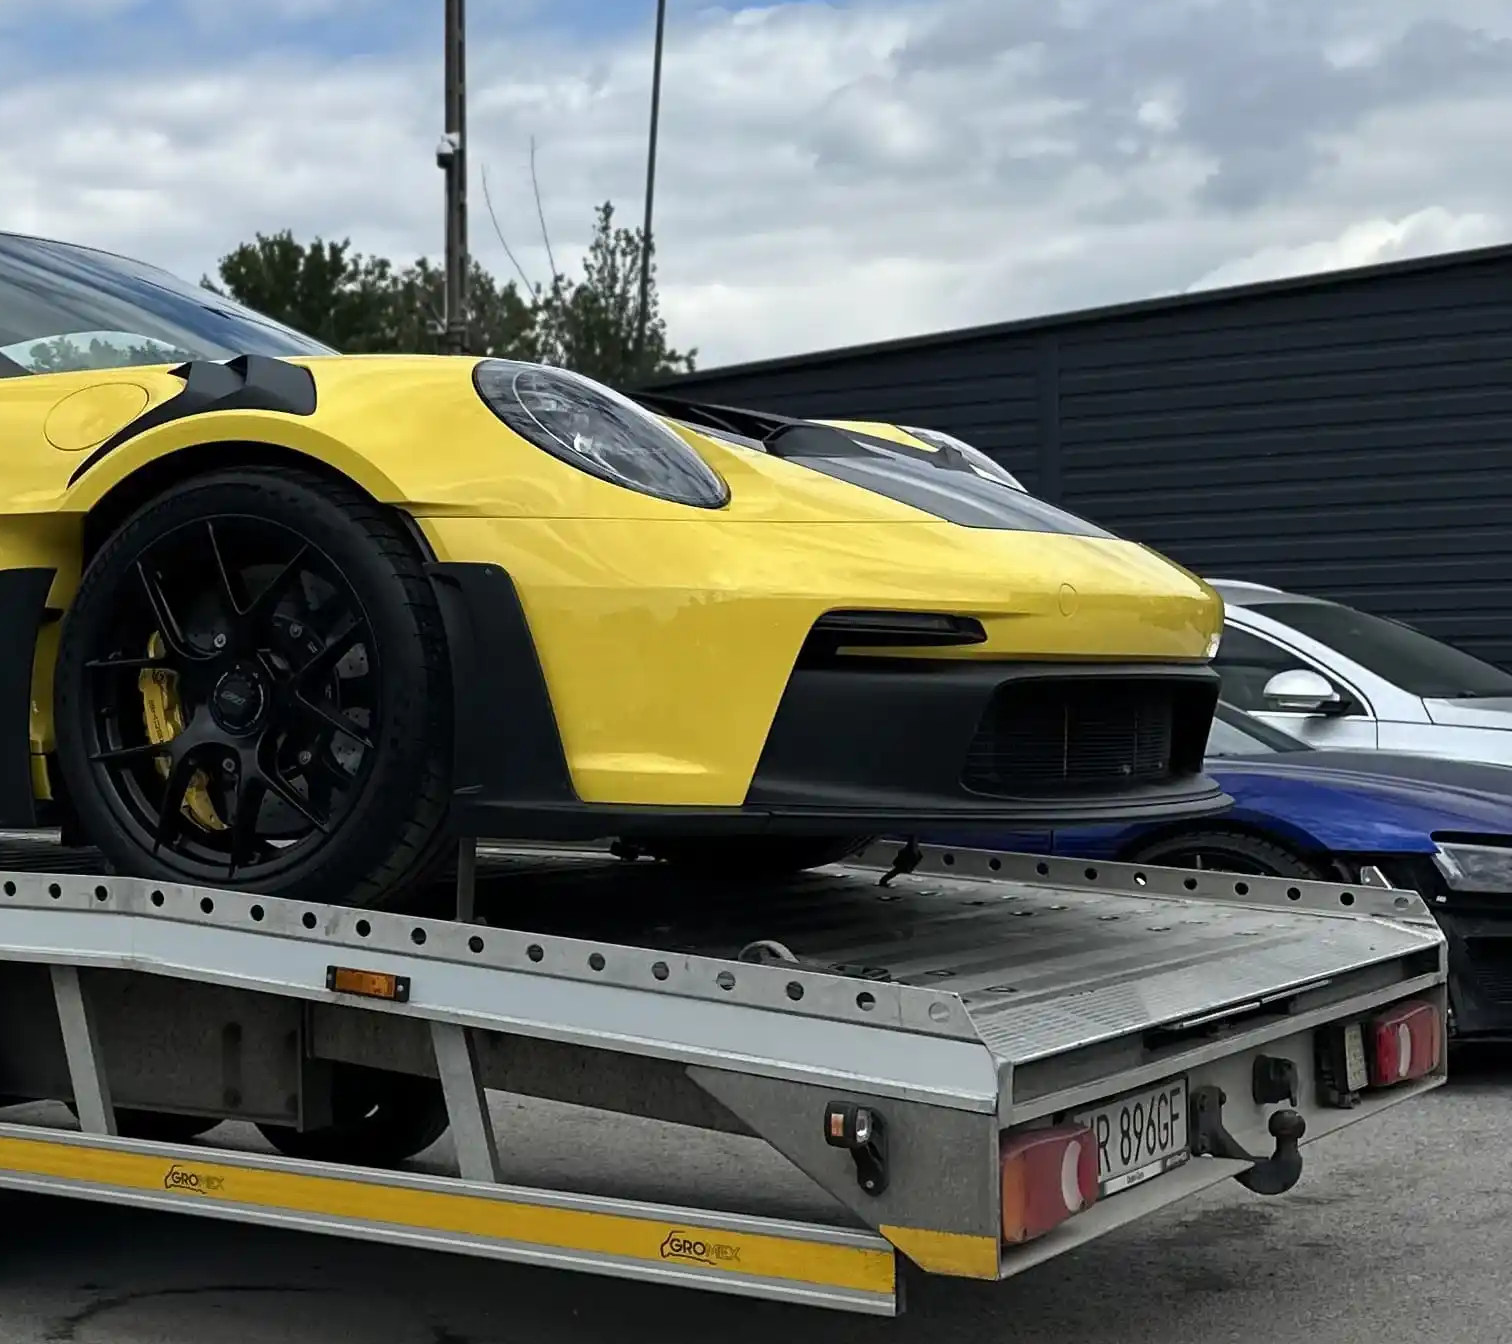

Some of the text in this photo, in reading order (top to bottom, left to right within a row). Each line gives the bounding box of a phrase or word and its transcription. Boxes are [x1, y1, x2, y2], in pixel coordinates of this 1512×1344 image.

[1090, 1086, 1181, 1177] R 896GF
[668, 1237, 741, 1263] GROMEX
